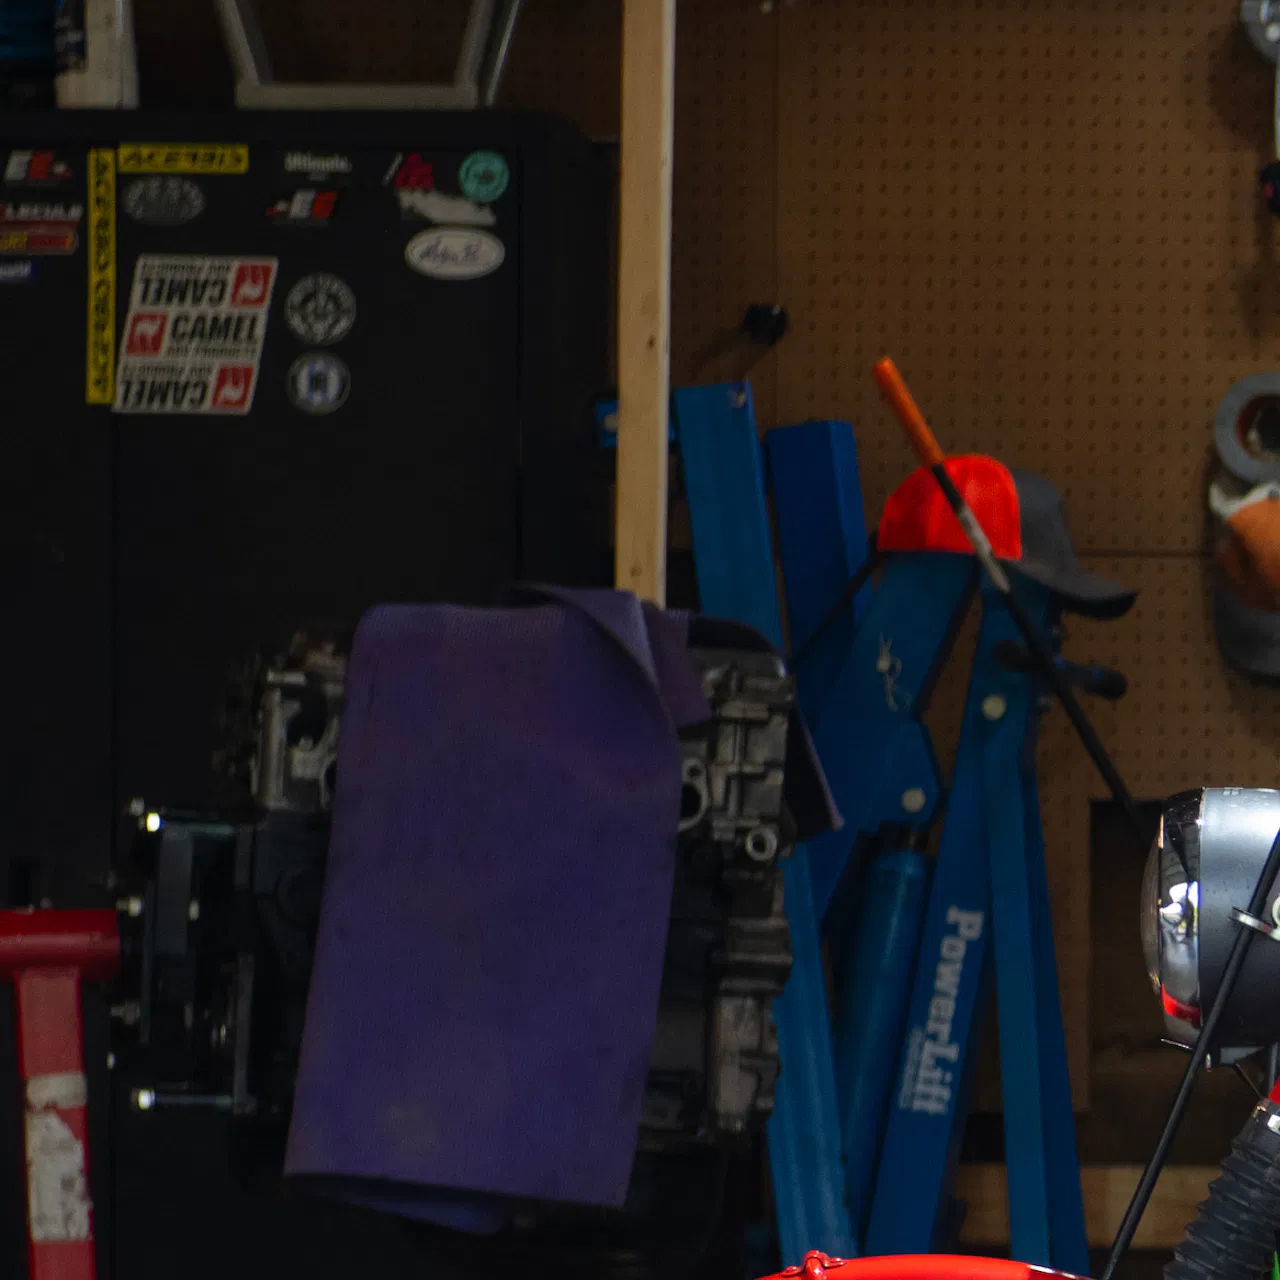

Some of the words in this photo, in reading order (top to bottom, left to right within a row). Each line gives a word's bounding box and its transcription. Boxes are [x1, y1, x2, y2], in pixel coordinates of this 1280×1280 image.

[139, 277, 228, 305] CAMEL
[171, 314, 260, 341] CAMEL
[121, 378, 209, 407] CAMEL
[911, 905, 985, 1116] PowerLift
